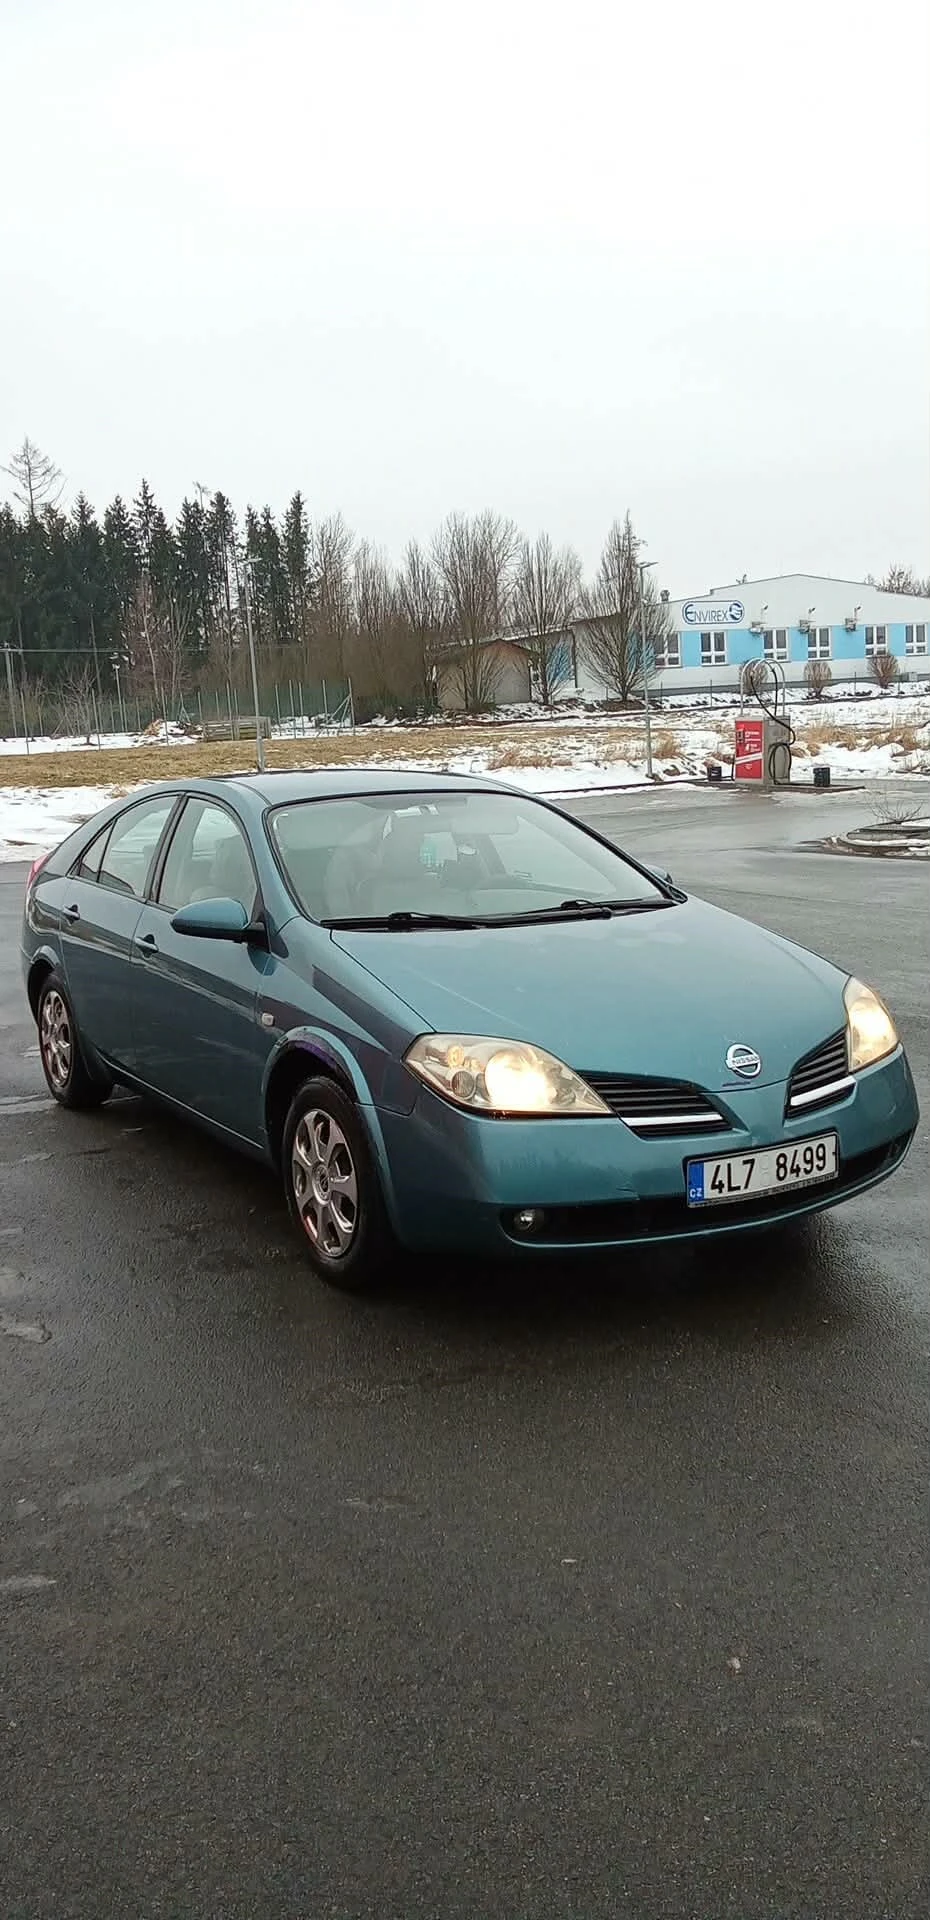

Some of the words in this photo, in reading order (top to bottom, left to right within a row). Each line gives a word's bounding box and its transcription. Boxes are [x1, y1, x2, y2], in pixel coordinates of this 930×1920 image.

[710, 1158, 756, 1194] 4L7
[775, 1143, 827, 1182] 8499
[689, 1187, 703, 1199] CZ
